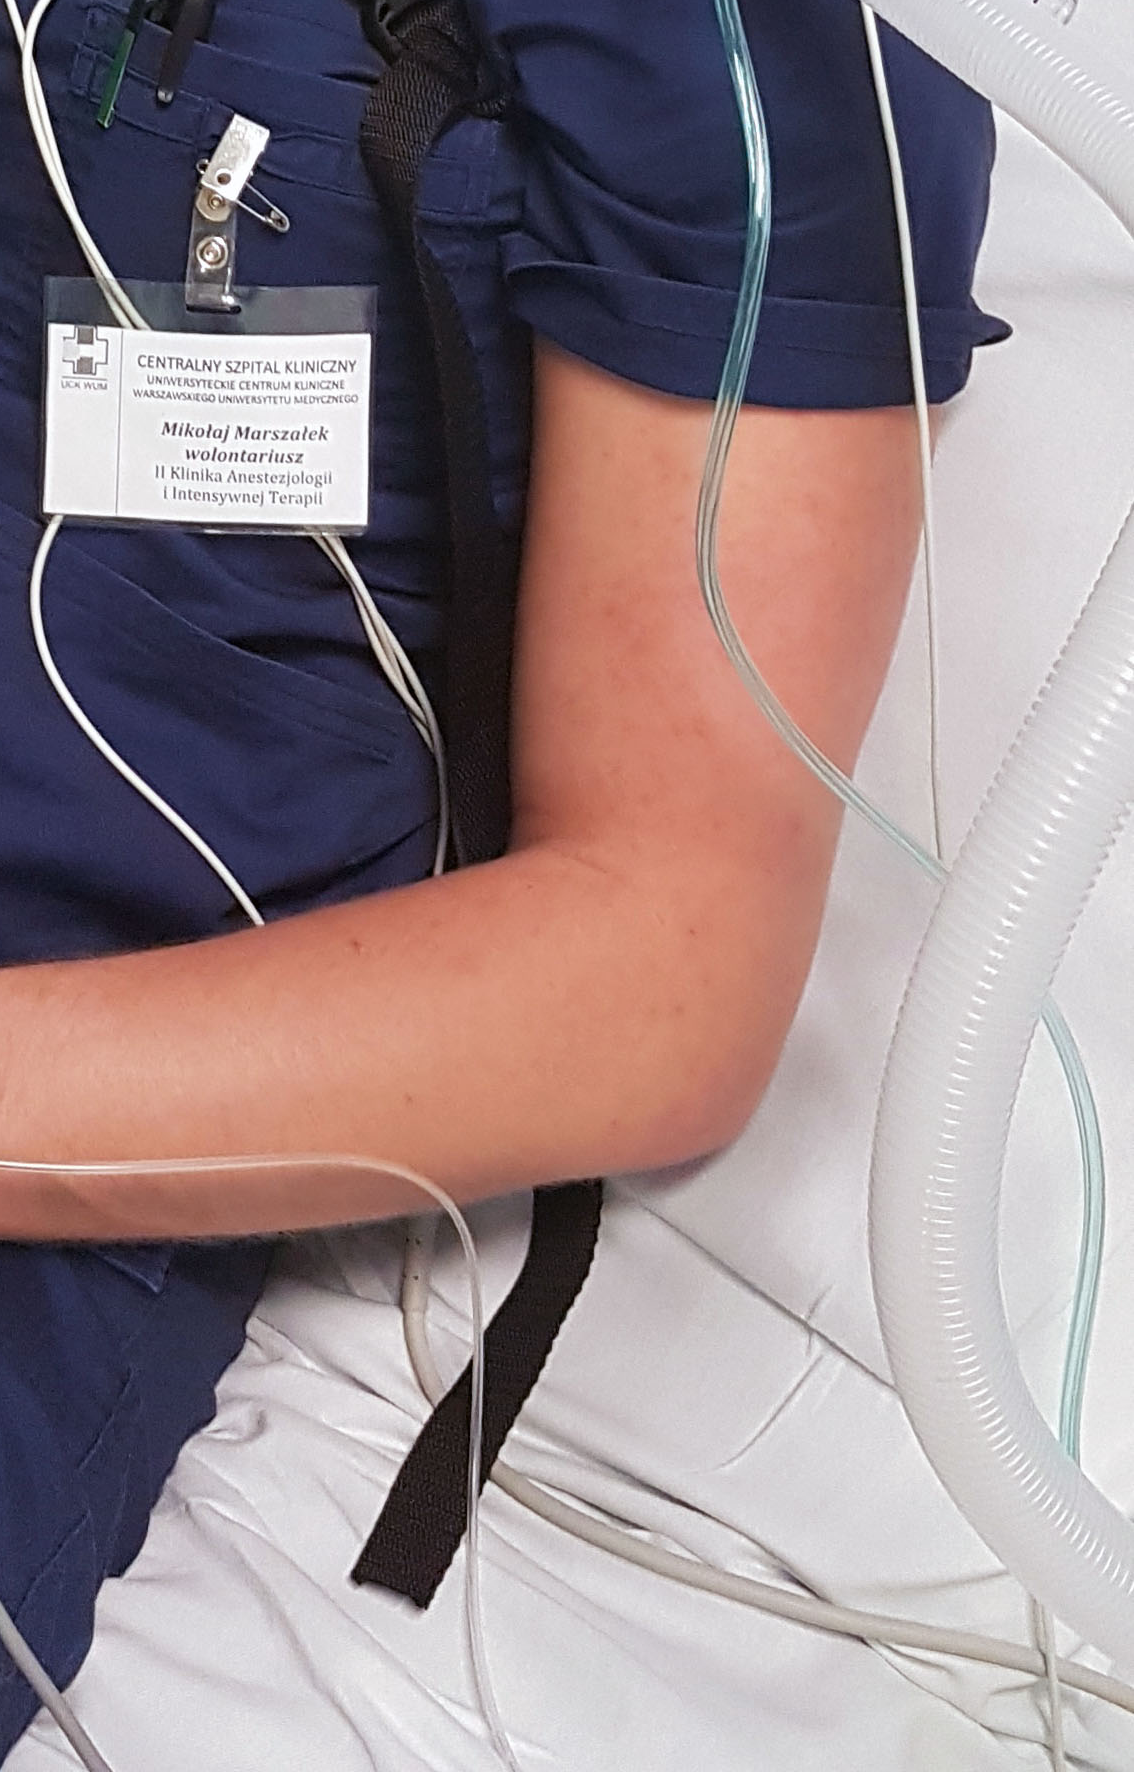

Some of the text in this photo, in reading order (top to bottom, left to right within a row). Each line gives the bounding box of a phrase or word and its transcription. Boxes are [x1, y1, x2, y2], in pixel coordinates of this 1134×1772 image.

[137, 354, 357, 374] CENTRALNY SZPITAL KLINICZNY
[146, 375, 345, 390] UNIWERSYTECKIE CENTRUM KLINICZNE
[132, 388, 359, 405] WARSZAWSKIEGO UNIWERSYTETU MEDYCZNEGO
[161, 421, 329, 443] Mikołaj Marszałek
[185, 447, 304, 464] wolontariusz
[154, 465, 333, 488] II Klinika Anestezjologii
[172, 485, 265, 508] Intensywnej
[268, 489, 324, 509] Terapii
